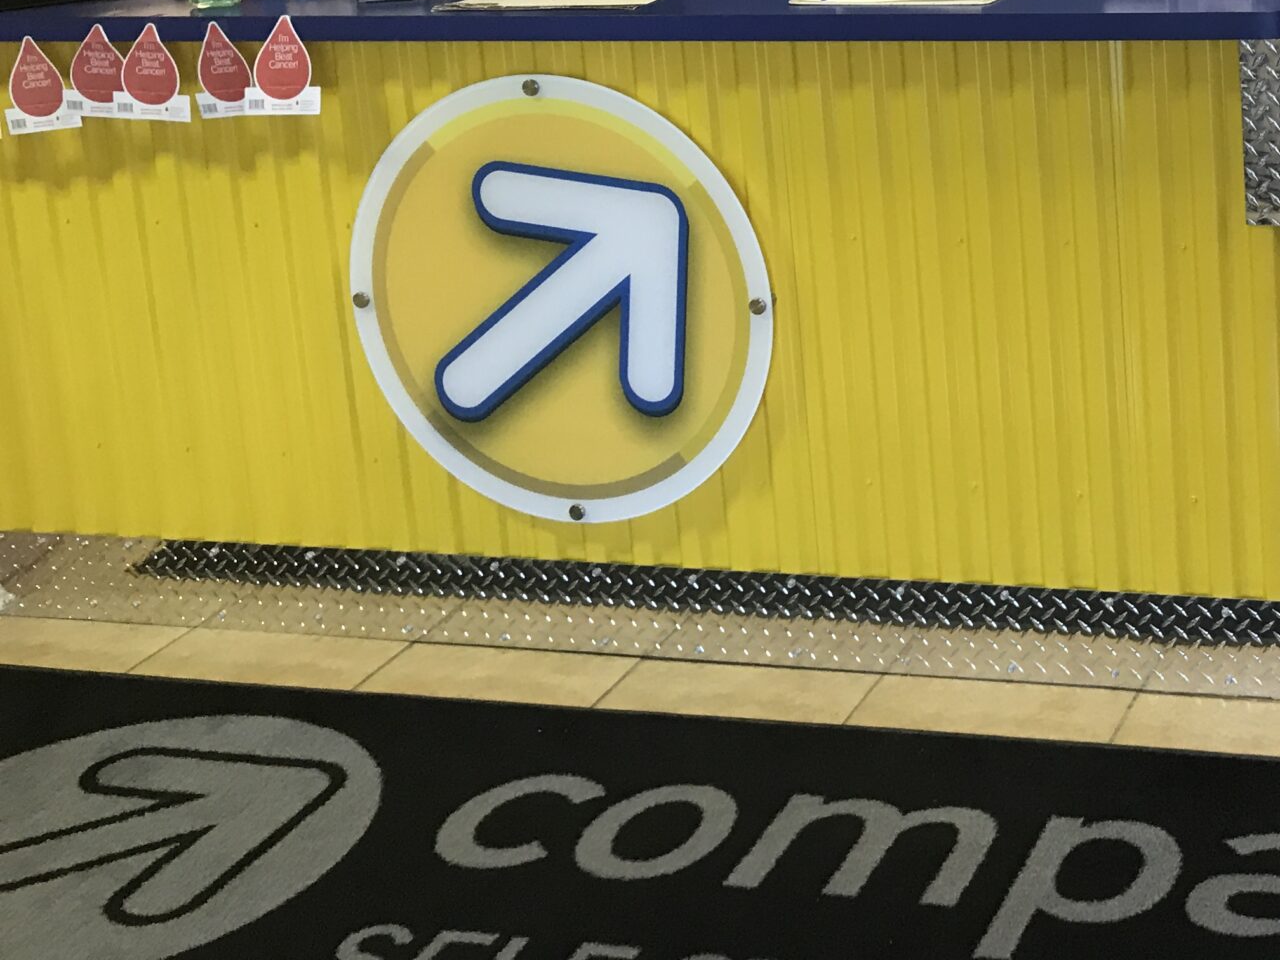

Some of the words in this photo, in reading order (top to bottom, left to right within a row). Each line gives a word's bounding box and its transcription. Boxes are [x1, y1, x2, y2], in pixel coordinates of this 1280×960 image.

[269, 43, 299, 54] Helping
[83, 49, 115, 61] Helping
[135, 49, 165, 61] Helping
[206, 49, 234, 59] Helping
[274, 52, 293, 61] Beat
[20, 62, 49, 72] Helping
